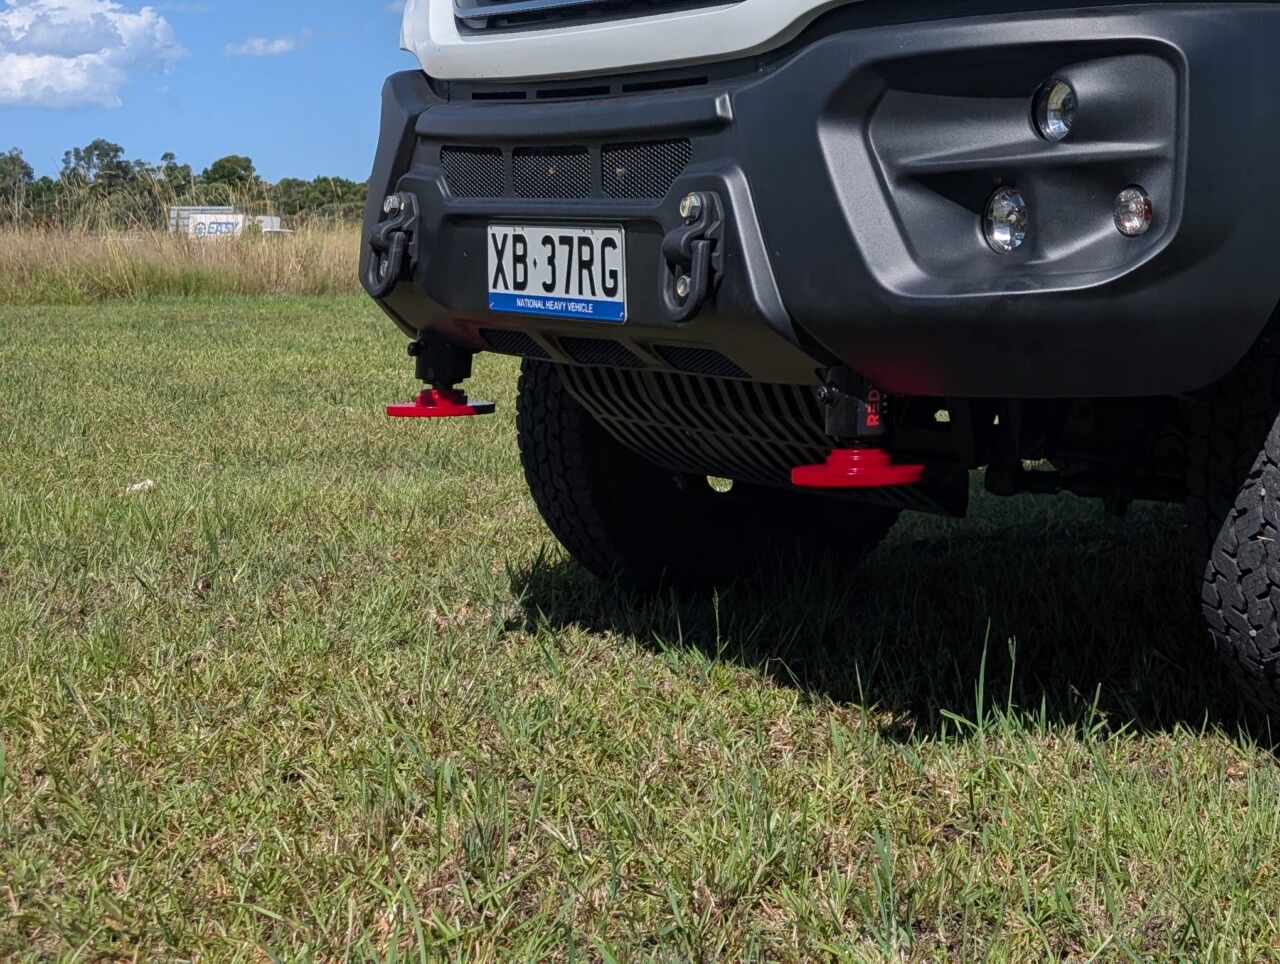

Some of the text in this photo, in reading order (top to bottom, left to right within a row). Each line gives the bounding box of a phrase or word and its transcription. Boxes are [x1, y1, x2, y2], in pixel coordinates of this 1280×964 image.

[516, 298, 594, 314] NATIONAL HEAVY VEHICLE
[866, 388, 881, 427] RED
